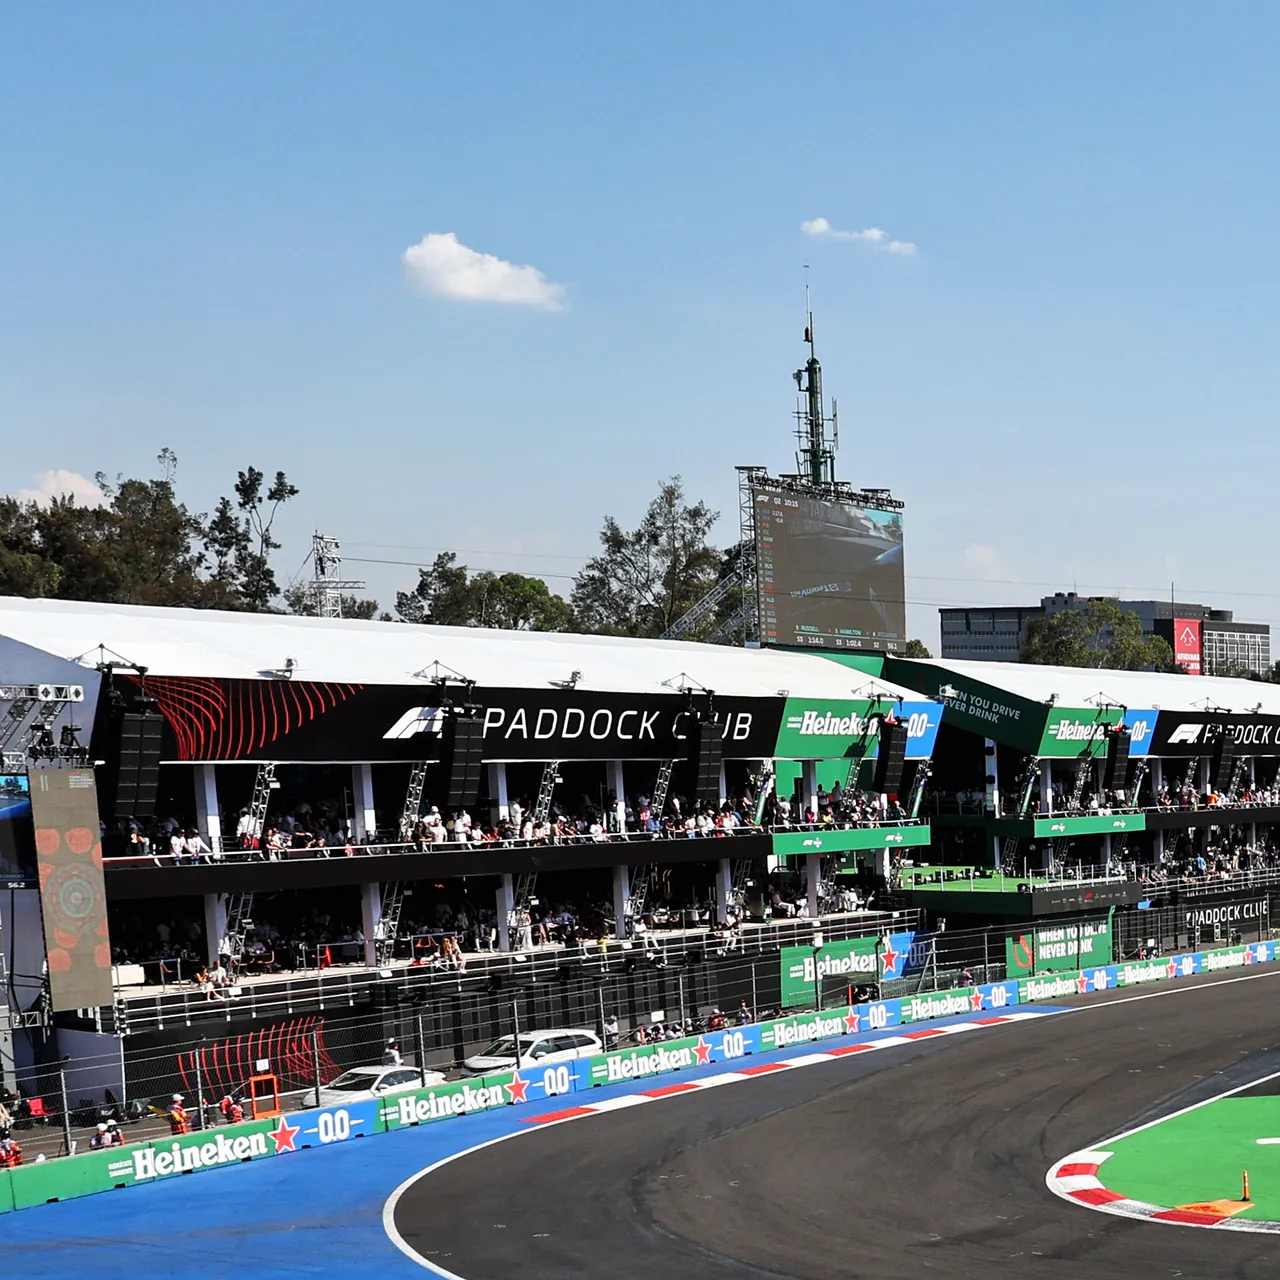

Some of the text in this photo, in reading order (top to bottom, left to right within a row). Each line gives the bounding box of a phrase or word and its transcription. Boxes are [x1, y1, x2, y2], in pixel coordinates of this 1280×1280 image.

[944, 698, 1000, 724] EVER DRINK
[969, 692, 1021, 721] YOU DRIVE
[482, 708, 752, 741] PADDOCK CUB
[1038, 925, 1064, 943] WHEN
[1039, 938, 1093, 960] NEVER DRNK
[1207, 951, 1243, 970] Heineken
[1026, 972, 1076, 999] Heineken
[1093, 966, 1107, 989] 0.0
[1124, 962, 1167, 984] Heineken
[911, 991, 970, 1020] Heineken
[991, 983, 1006, 1007] 0.0
[868, 1003, 887, 1028] 0.0
[773, 1014, 843, 1047] Heineken
[723, 1031, 743, 1059] 0.0
[607, 1046, 692, 1081] Heineken
[543, 1065, 570, 1095] 0.0
[399, 1083, 505, 1125] Heineken
[317, 1109, 350, 1144] 0.0
[132, 1130, 268, 1181] Heineken
